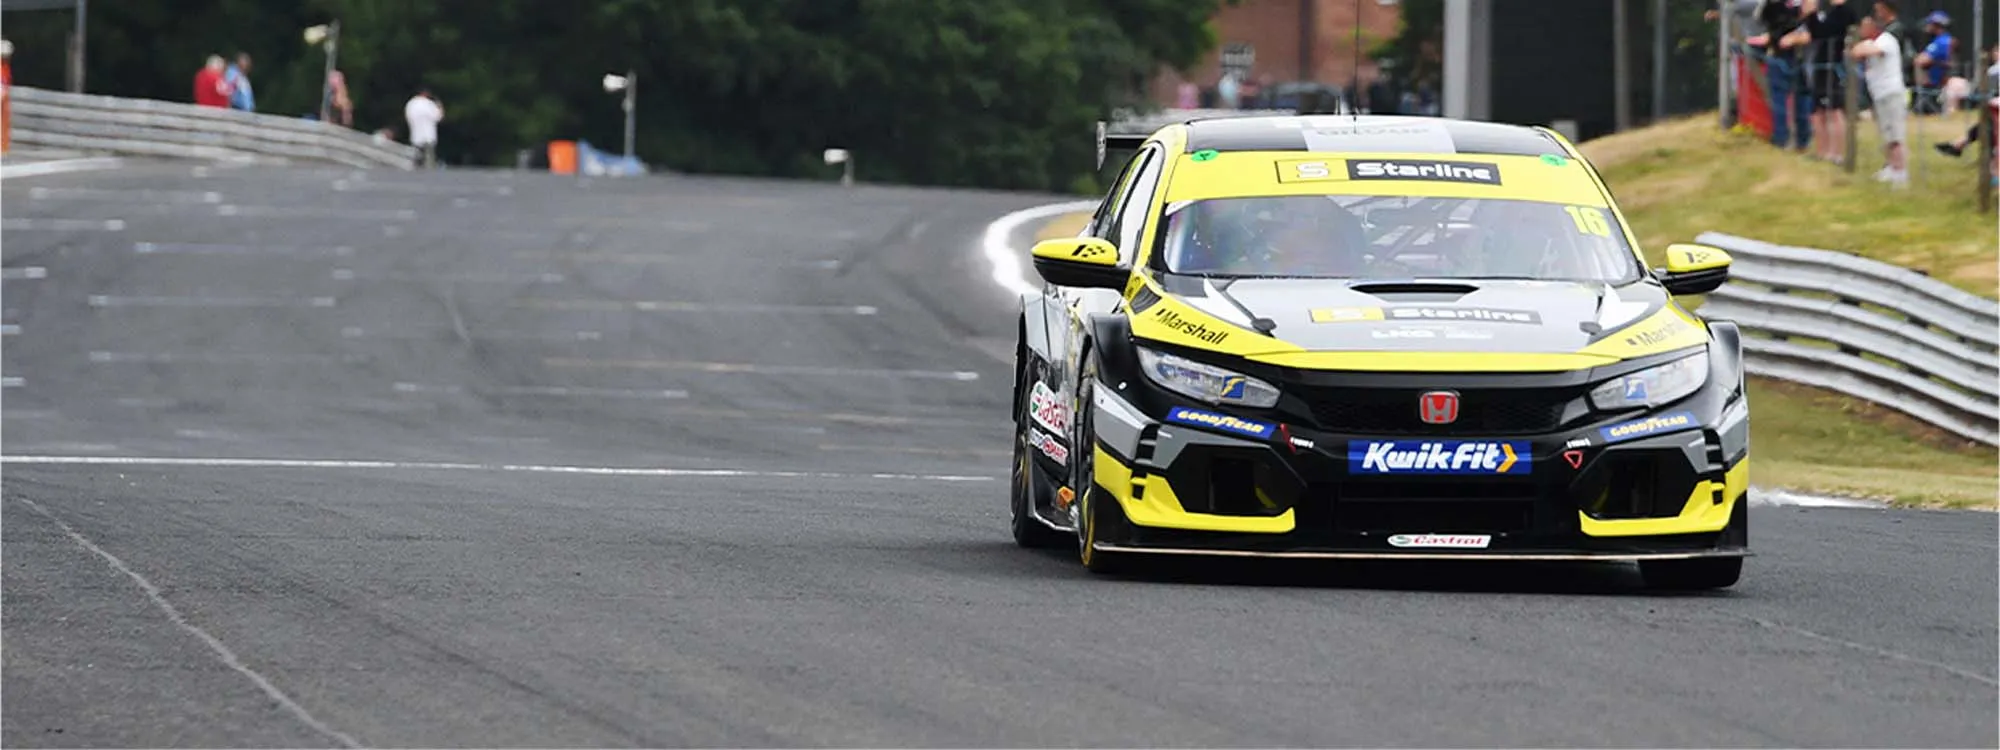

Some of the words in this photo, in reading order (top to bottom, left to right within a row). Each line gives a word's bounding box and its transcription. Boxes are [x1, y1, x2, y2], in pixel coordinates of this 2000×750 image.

[1355, 161, 1492, 181] Starline
[1563, 206, 1611, 238] 16
[1391, 306, 1531, 322] Starline
[1157, 309, 1230, 345] Marshall
[1177, 410, 1265, 433] GOODYEAR
[1610, 415, 1689, 437] GOODYEAR
[1413, 535, 1483, 546] Castrol
